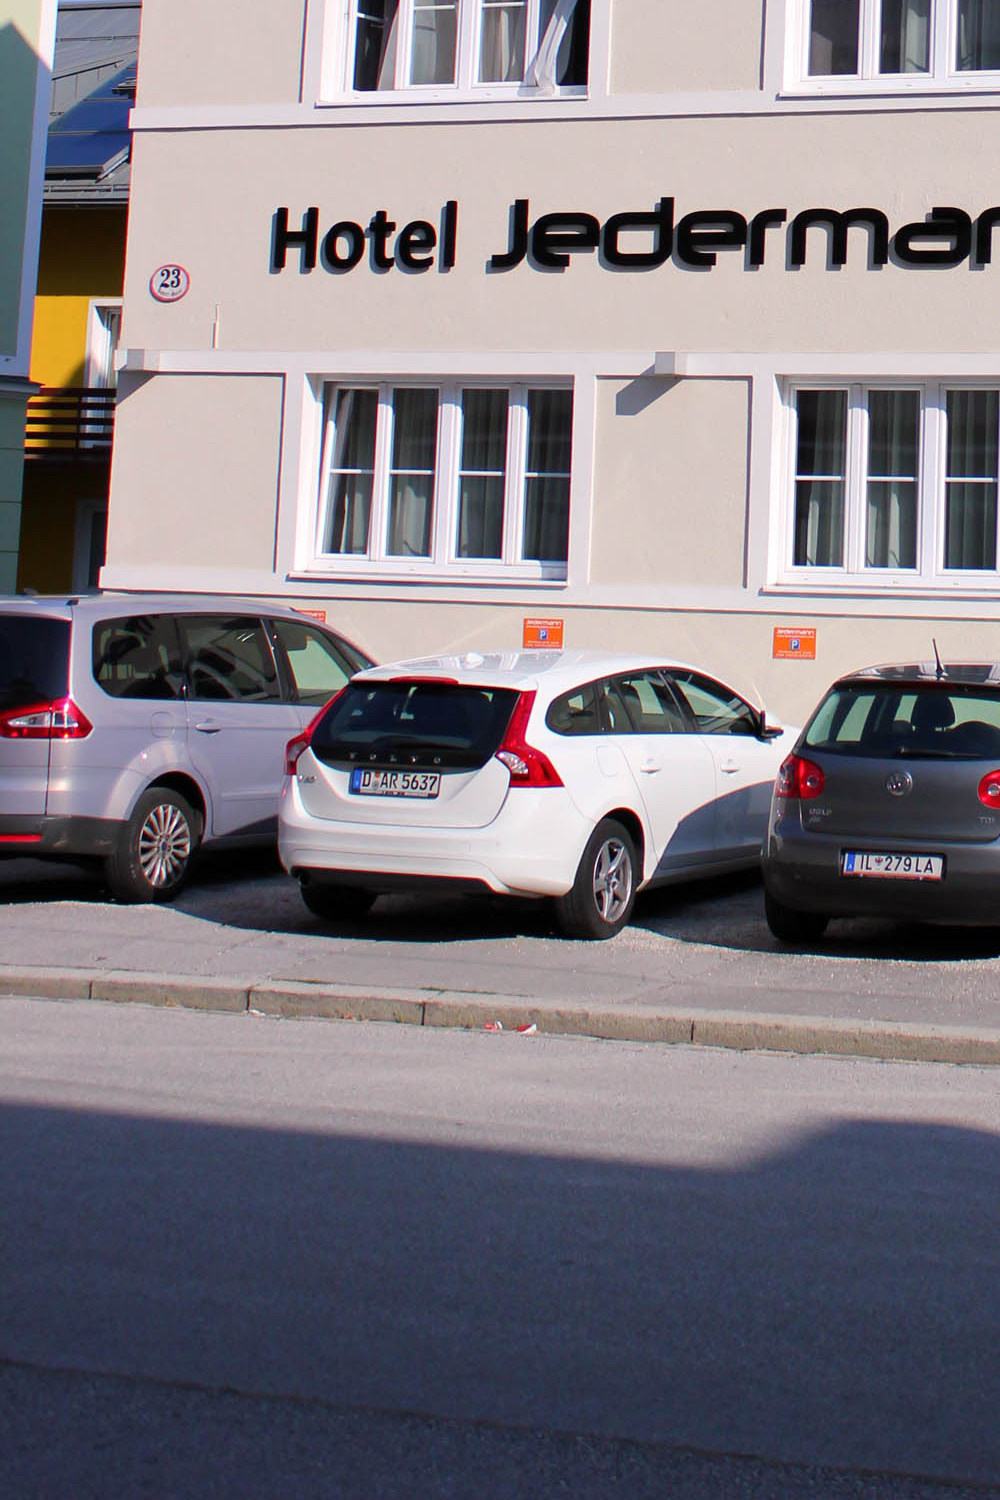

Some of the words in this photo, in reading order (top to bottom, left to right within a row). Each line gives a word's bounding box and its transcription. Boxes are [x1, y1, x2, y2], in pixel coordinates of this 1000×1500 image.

[273, 200, 459, 269] Hotel
[160, 268, 181, 288] 23
[362, 771, 372, 787] D
[380, 772, 398, 789] AR
[401, 774, 438, 792] 5637
[860, 856, 873, 871] IL
[884, 856, 912, 872] 279
[915, 857, 934, 874] LA
